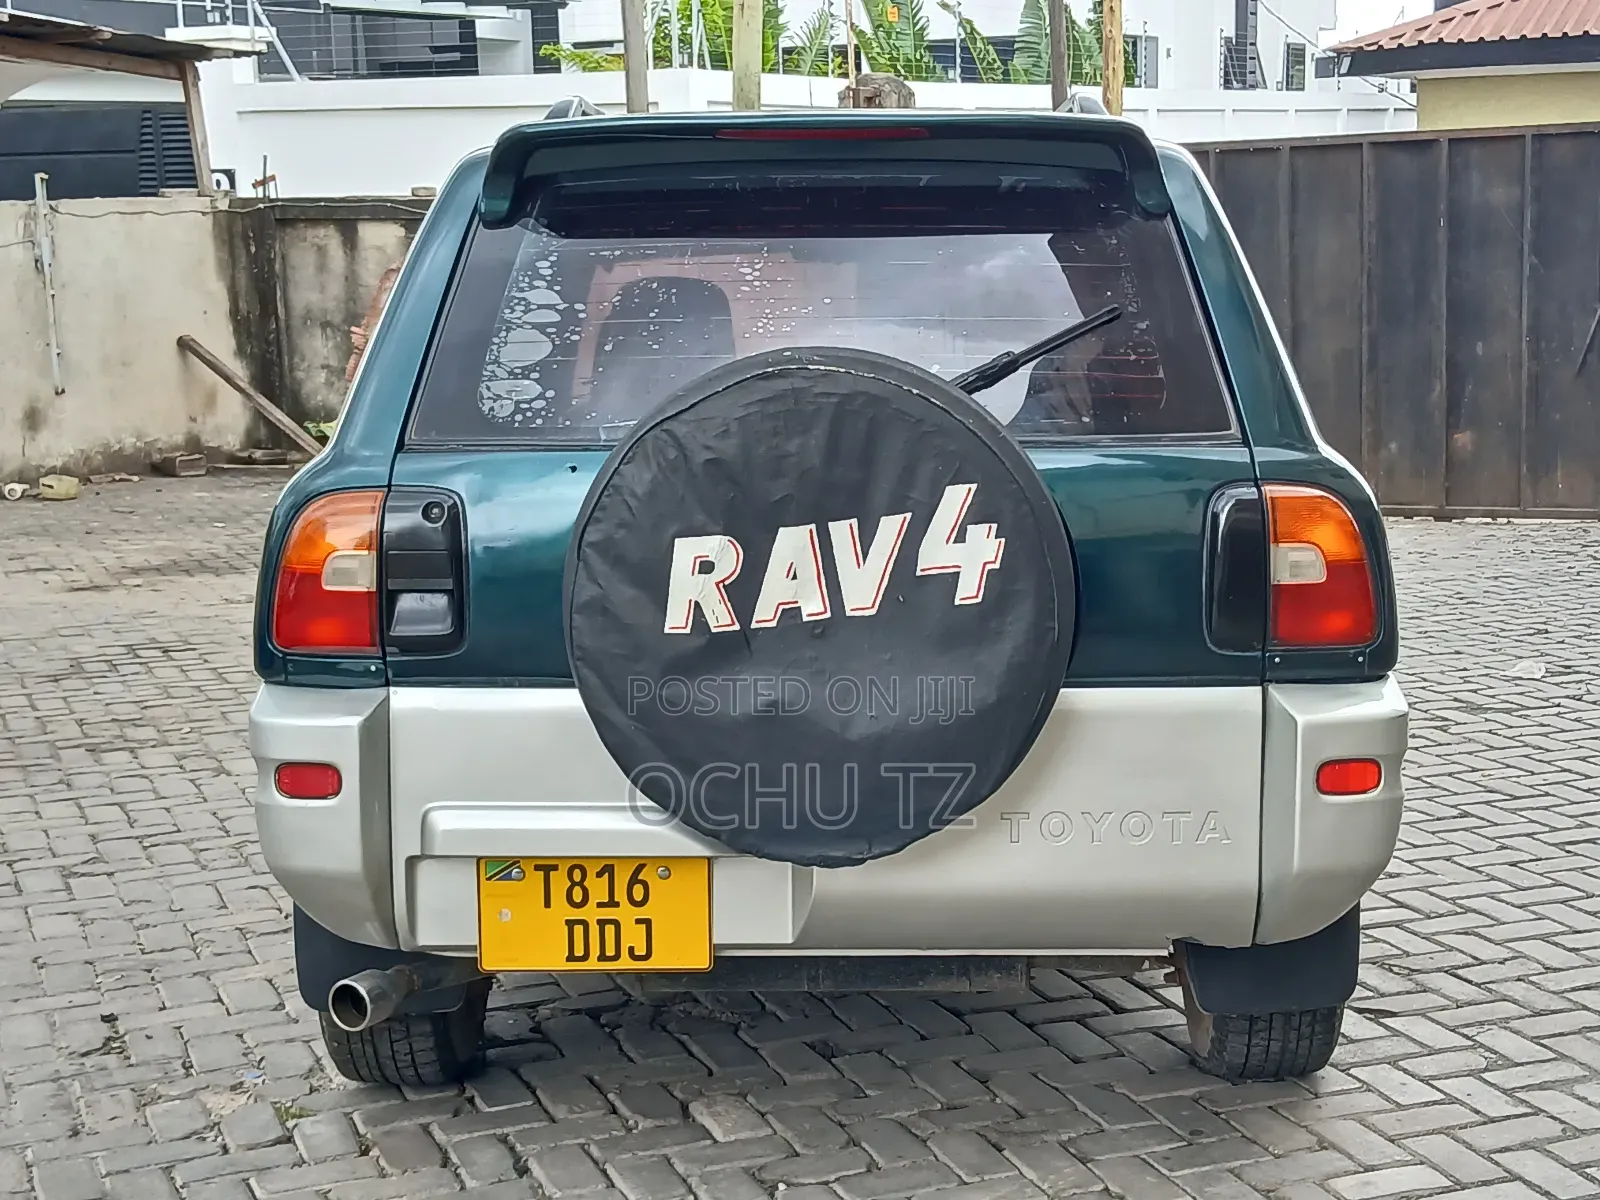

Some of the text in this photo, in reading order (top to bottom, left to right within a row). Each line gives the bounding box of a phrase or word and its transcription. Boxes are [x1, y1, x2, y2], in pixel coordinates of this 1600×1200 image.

[664, 483, 1005, 633] RAV4
[1000, 810, 1232, 845] TOYOTA
[533, 863, 651, 909] T816
[565, 918, 653, 962] DDJ
